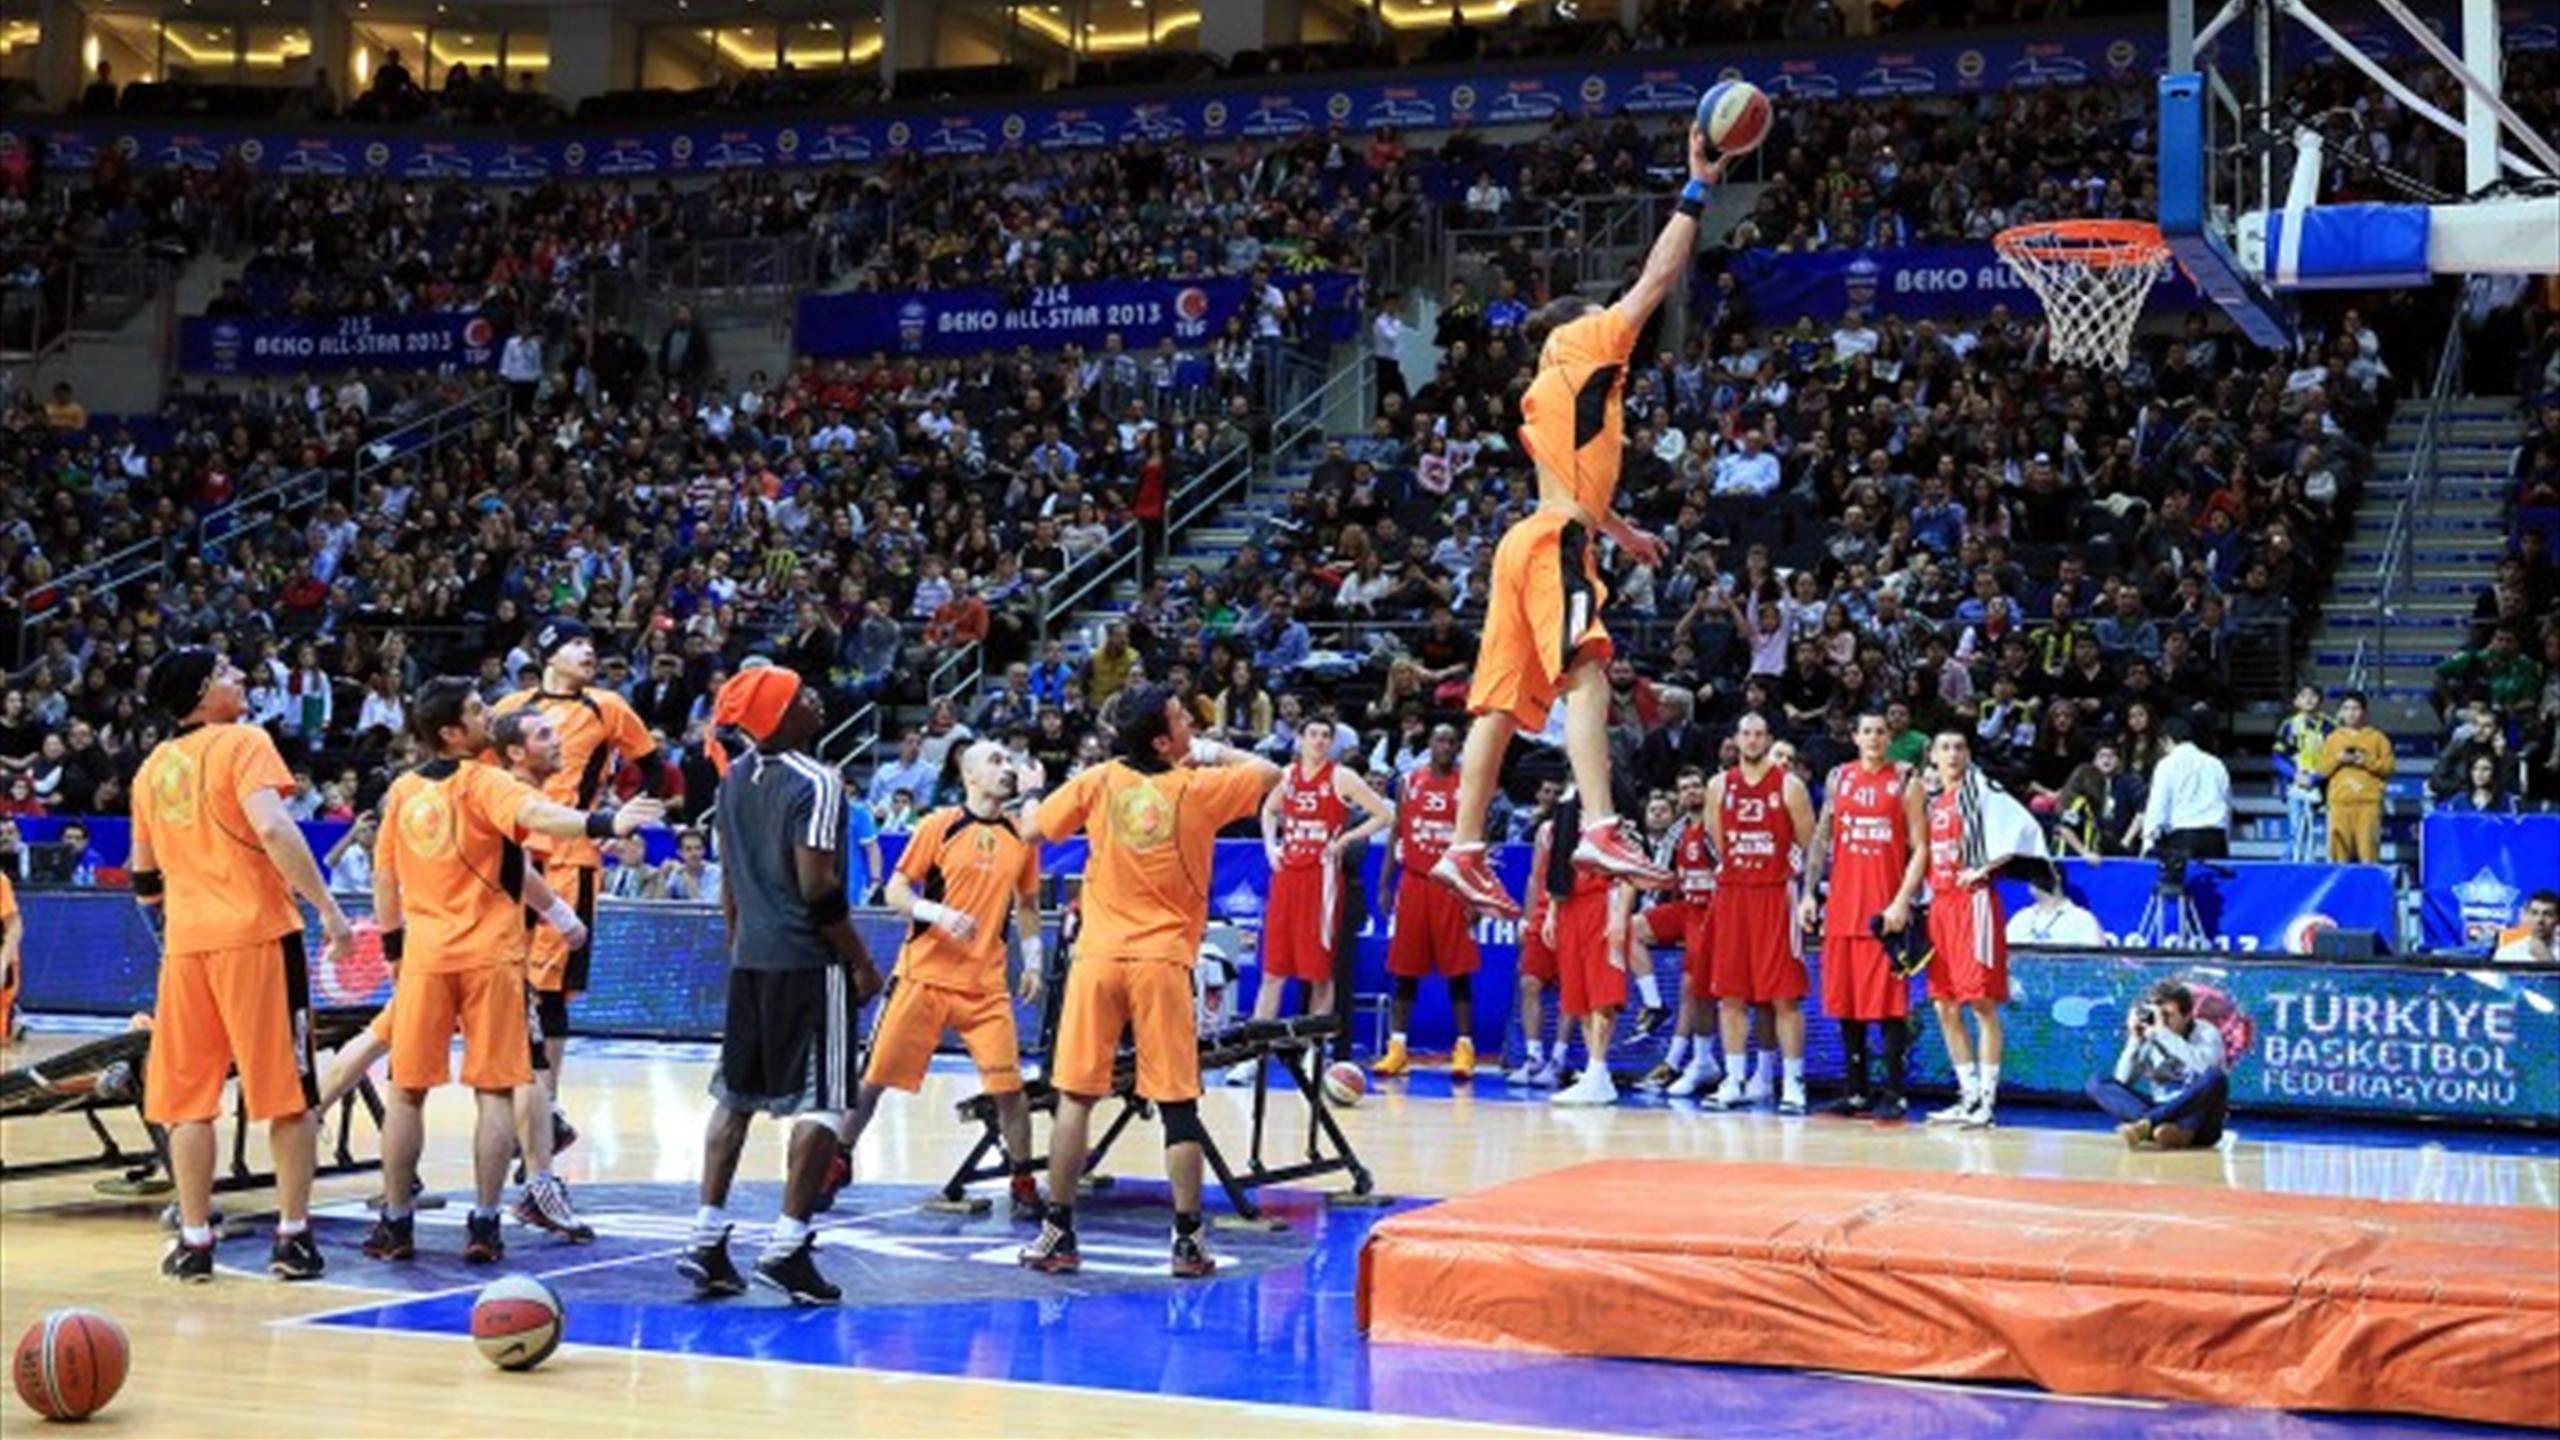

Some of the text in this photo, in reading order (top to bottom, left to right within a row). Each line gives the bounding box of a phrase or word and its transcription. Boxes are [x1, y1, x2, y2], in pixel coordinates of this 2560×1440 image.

[1895, 268, 1968, 292] BEKO
[1032, 286, 1070, 306] 214
[938, 310, 997, 332] BEKO
[1004, 305, 1099, 329] ALL-STAR
[1107, 301, 1161, 326] 2013
[254, 336, 313, 355] BEKO
[318, 332, 400, 355] ALL-STAR
[405, 330, 451, 351] 2013
[1738, 798, 1764, 822] 23
[2265, 980, 2517, 1042] TÜRKİYE
[2264, 1035, 2515, 1078] BASKETBOL
[2263, 1068, 2516, 1107] FEDERASYONU
